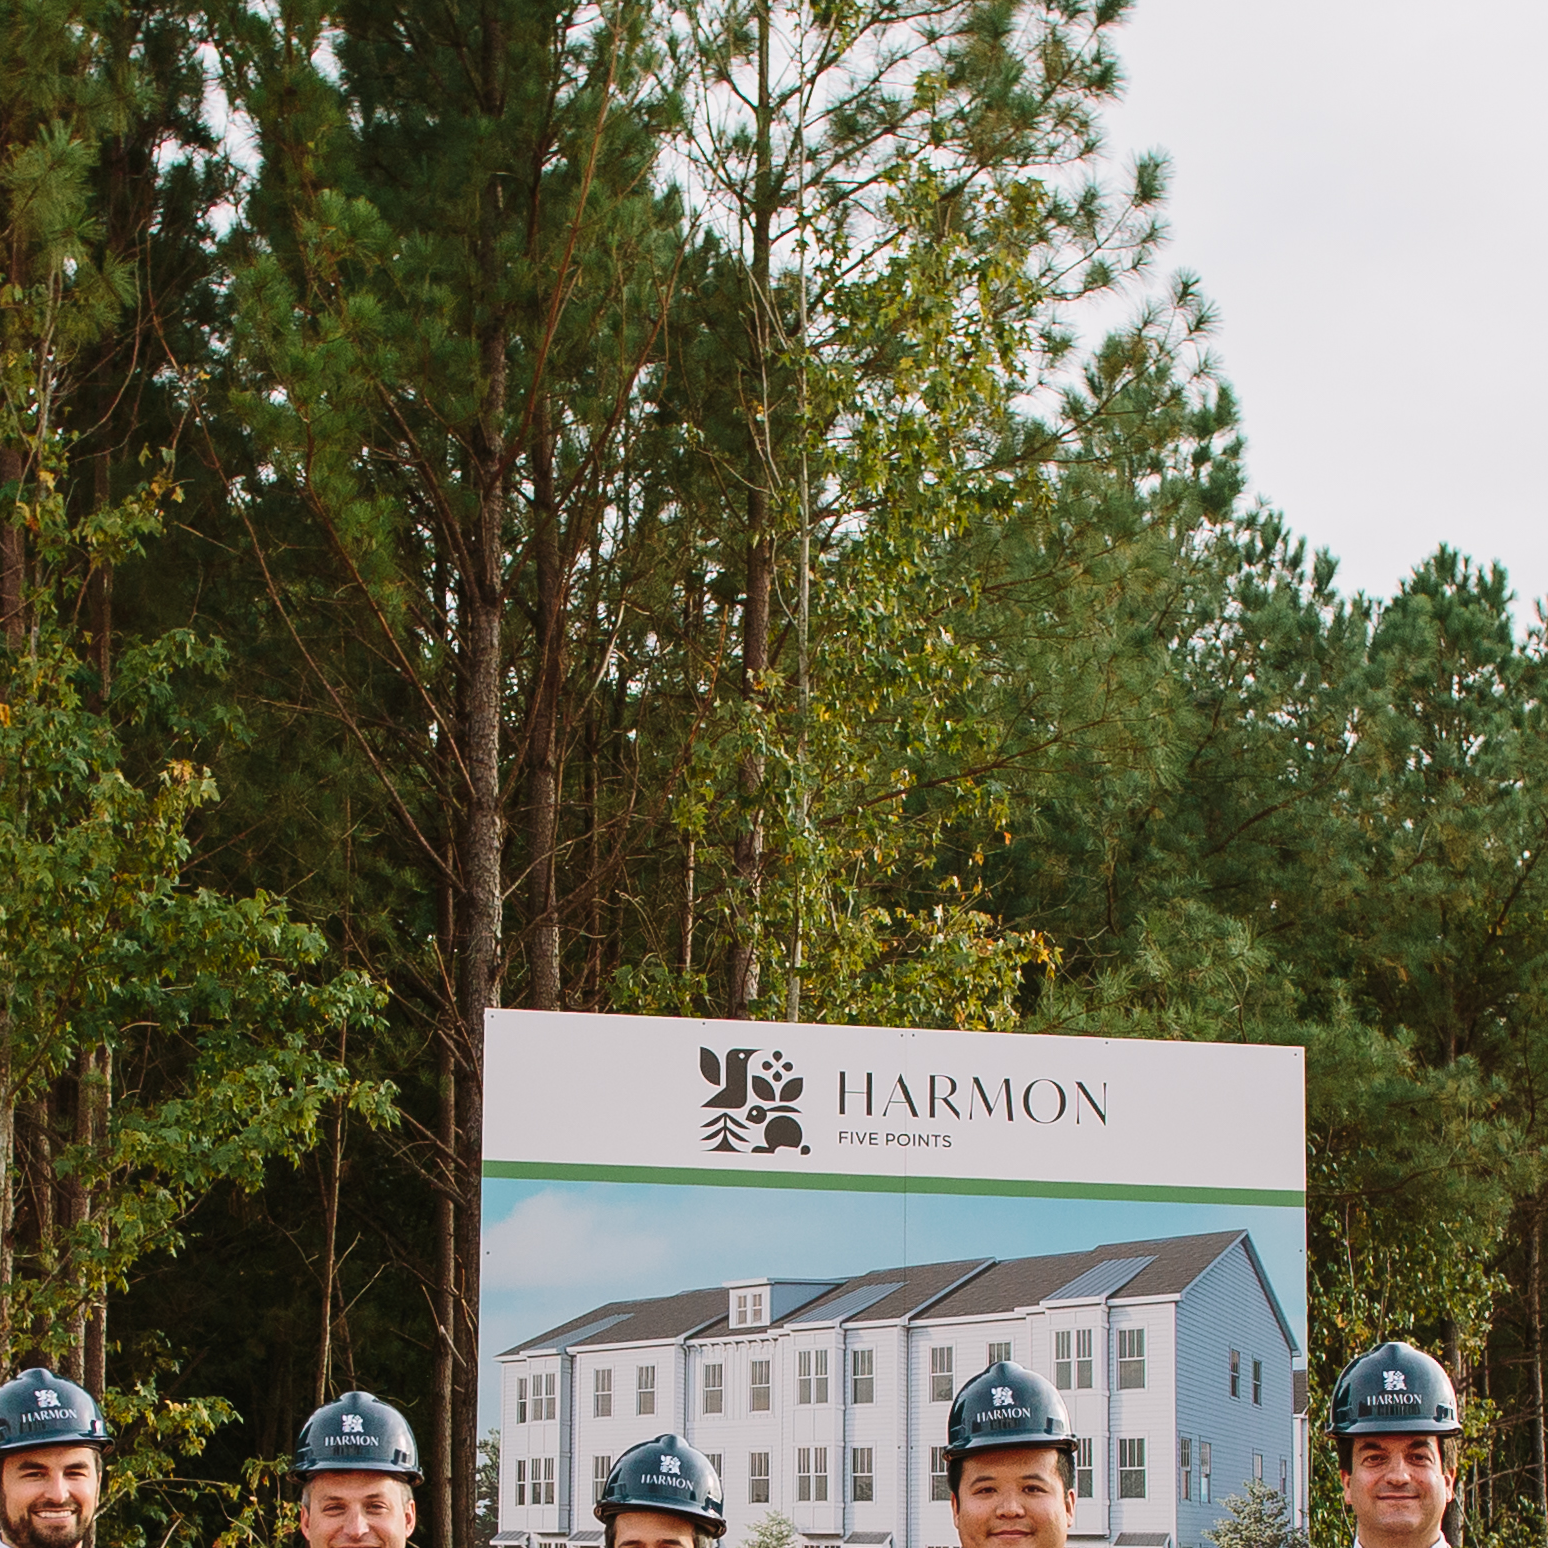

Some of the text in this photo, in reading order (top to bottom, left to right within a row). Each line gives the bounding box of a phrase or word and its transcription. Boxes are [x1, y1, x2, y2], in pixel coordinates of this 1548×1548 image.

[838, 1070, 1108, 1127] HARMON
[838, 1130, 952, 1148] FIVE POINTS
[1367, 1394, 1422, 1406] HARMON
[22, 1408, 78, 1423] HARMON
[976, 1407, 1031, 1423] HARMON
[324, 1435, 379, 1447] HARMON
[640, 1474, 694, 1491] HARMON
